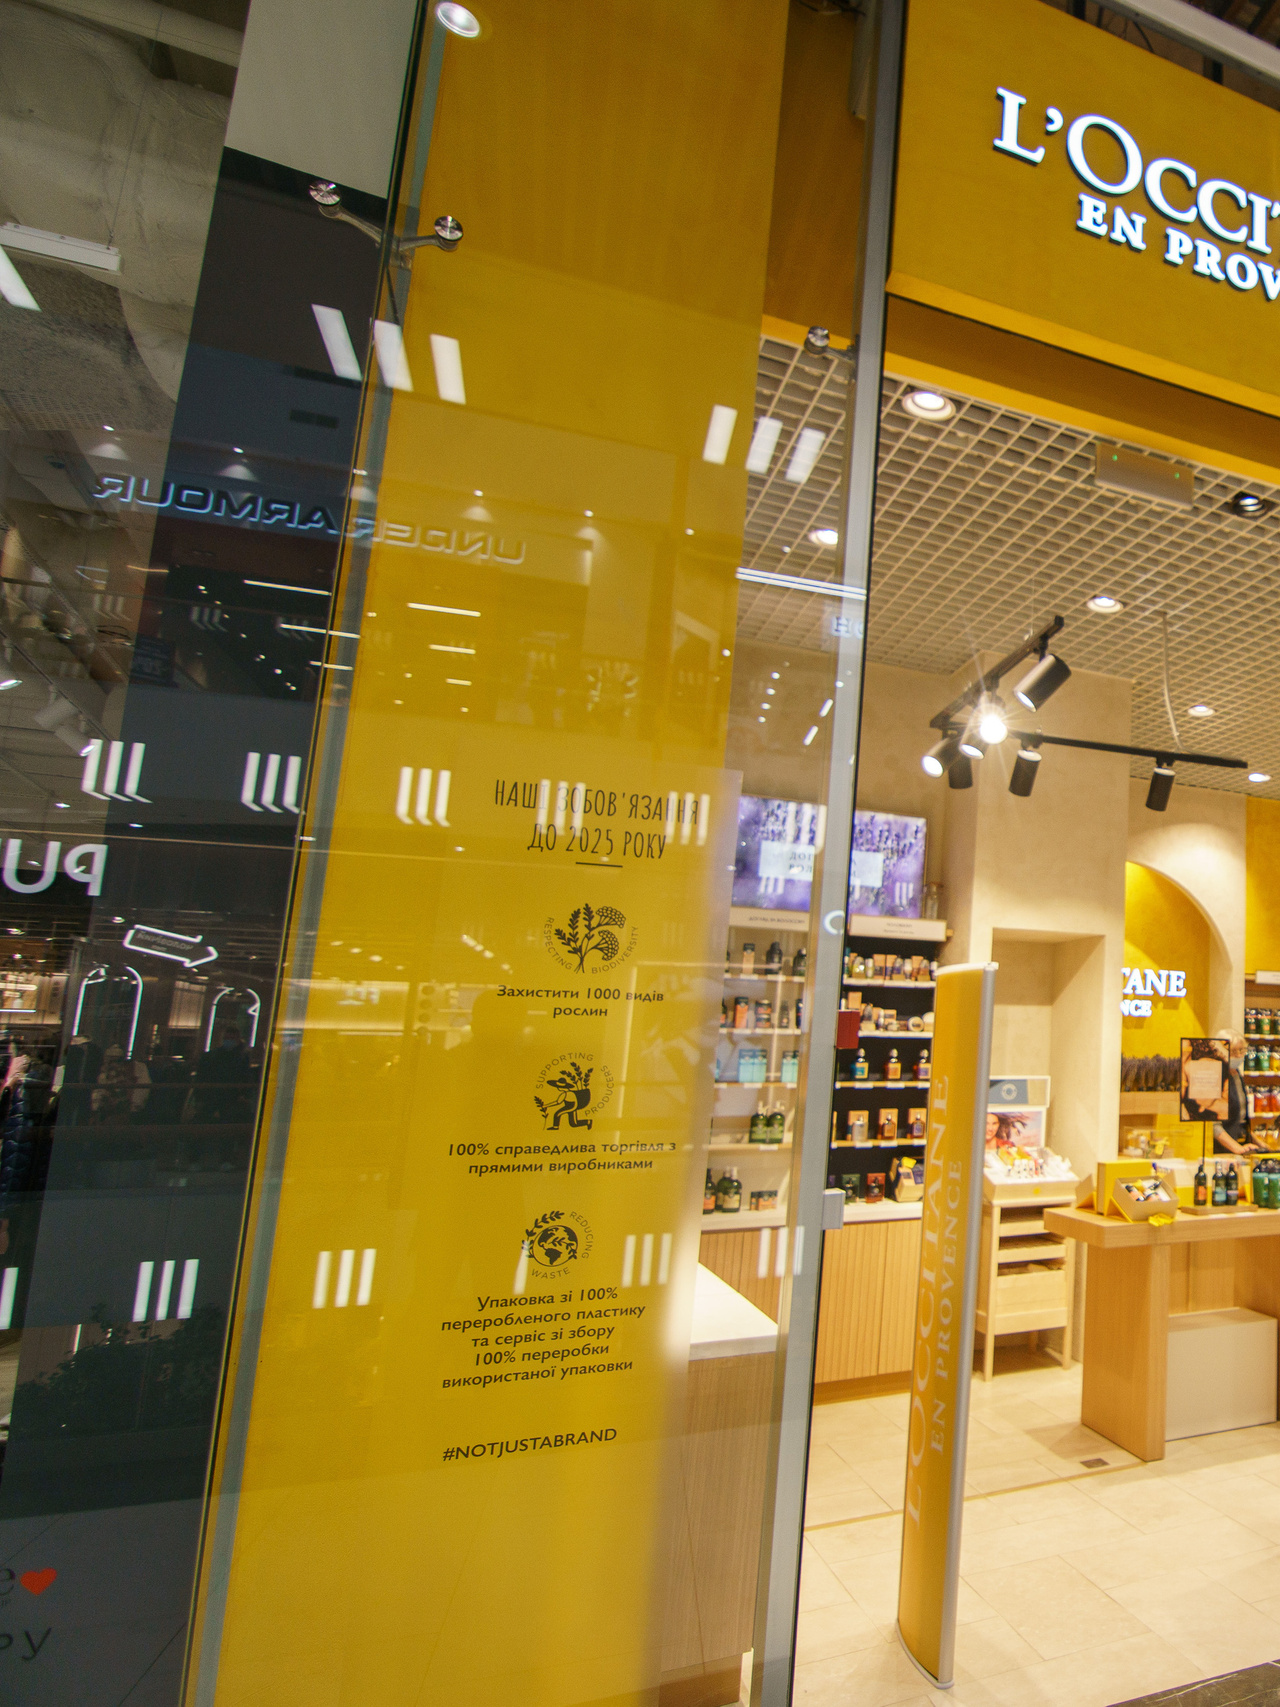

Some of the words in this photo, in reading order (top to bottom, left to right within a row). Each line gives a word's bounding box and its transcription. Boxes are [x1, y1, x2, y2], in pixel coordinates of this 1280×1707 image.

[1076, 193, 1147, 250] EN
[527, 823, 557, 852] ДО
[566, 825, 614, 855] 2025
[623, 831, 667, 859] РОКУ
[543, 917, 573, 970] RESPECTING
[591, 926, 639, 974] BIODIVERSITY
[497, 984, 579, 999] Захистити
[587, 987, 621, 1000] 1000
[625, 989, 665, 1003] видів
[553, 1006, 608, 1019] рослин
[535, 1052, 594, 1089] SUPPORTING
[584, 1065, 615, 1117] PRODUCERS
[448, 1143, 490, 1156] 100%
[495, 1143, 596, 1158] справедлива
[601, 1140, 664, 1155] торгівля
[468, 1163, 543, 1177] прямими
[548, 1158, 653, 1174] виробниками
[569, 1211, 594, 1259] REDUCING
[531, 1266, 571, 1280] WASTE
[934, 1160, 963, 1380] PROVENCE
[477, 1294, 555, 1312] Упаковка
[560, 1291, 573, 1303] зі
[579, 1287, 618, 1301] 100%
[441, 1312, 571, 1333] переробленого
[576, 1305, 646, 1320] пластику
[471, 1337, 489, 1347] та
[495, 1330, 546, 1347] сервіс
[551, 1328, 564, 1341] зі
[568, 1325, 615, 1340] збору
[475, 1350, 516, 1366] 100%
[521, 1343, 610, 1364] переробки
[442, 1366, 557, 1388] використаної
[560, 1361, 633, 1380] упаковки
[929, 1398, 946, 1455] EN
[443, 1428, 618, 1462] #NOTJUSTABRAND
